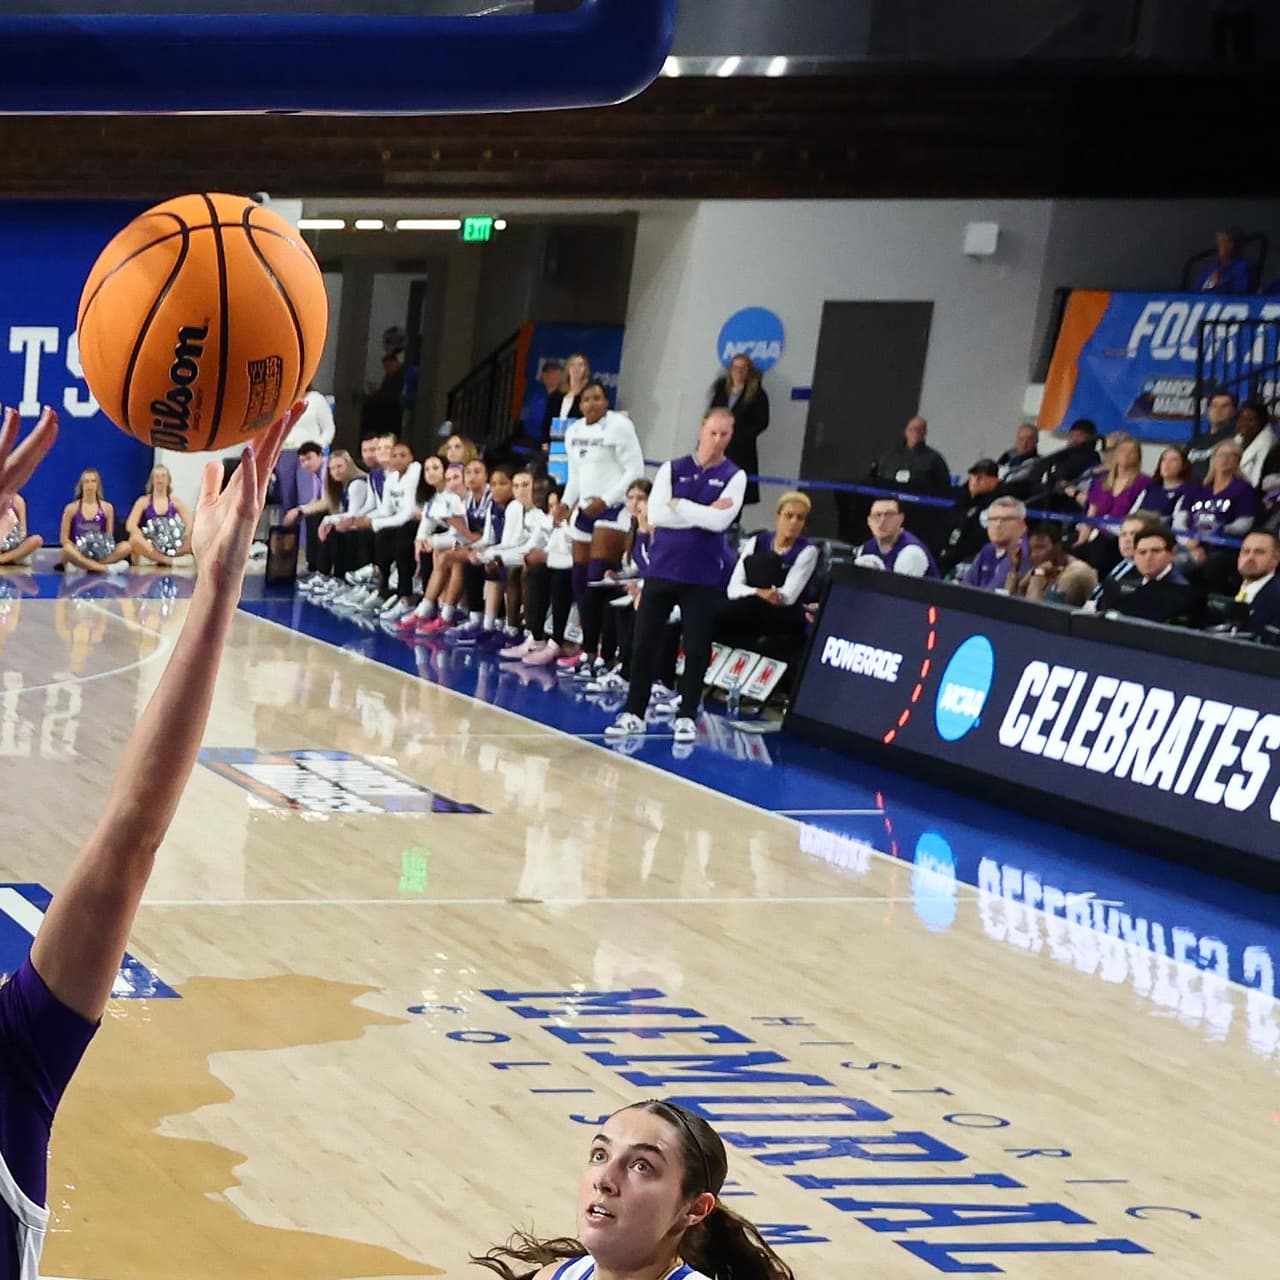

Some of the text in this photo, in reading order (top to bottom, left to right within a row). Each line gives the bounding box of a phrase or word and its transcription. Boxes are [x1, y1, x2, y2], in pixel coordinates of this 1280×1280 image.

[150, 325, 209, 449] Wilson
[821, 636, 903, 682] POWERADE
[938, 660, 1278, 812] NCAA CELEBRATES
[481, 987, 1155, 1275] MEMORIAL
